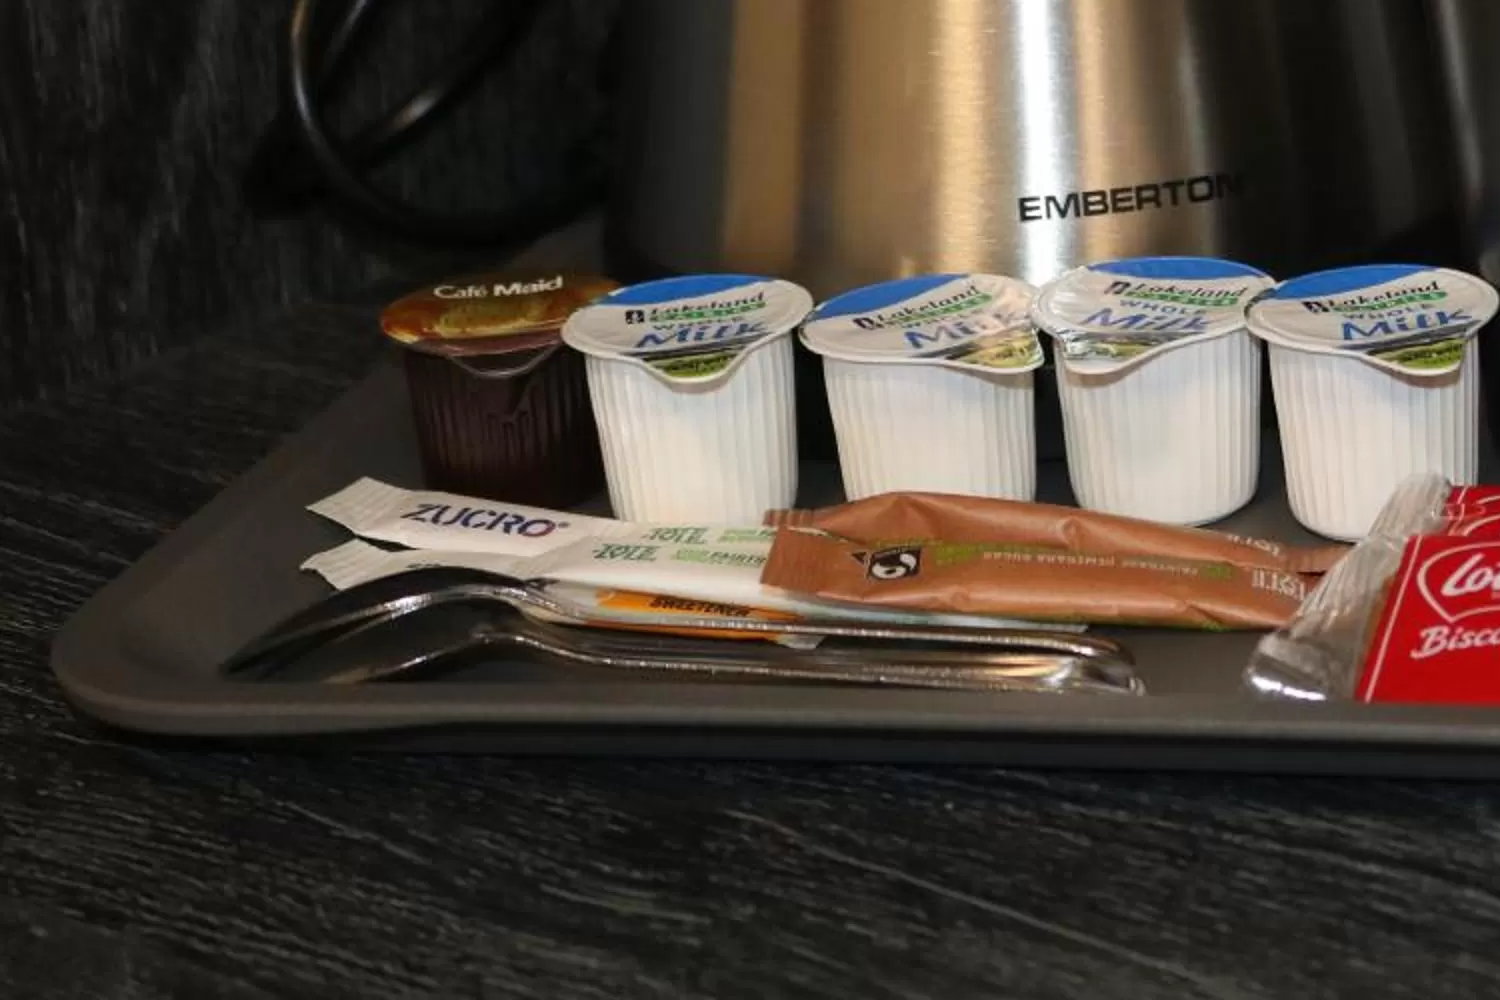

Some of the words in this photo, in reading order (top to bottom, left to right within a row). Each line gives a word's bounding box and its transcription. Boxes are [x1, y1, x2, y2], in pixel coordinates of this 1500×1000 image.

[1018, 172, 1245, 222] EMBERTON
[433, 284, 489, 299] Café
[493, 275, 563, 297] Maid
[1134, 282, 1248, 298] Lakeland
[1330, 280, 1441, 308] Lakeland
[1080, 308, 1210, 331] Milk
[1342, 309, 1473, 340] Milk
[635, 321, 767, 348] Milk
[401, 503, 556, 538] ZUCRO
